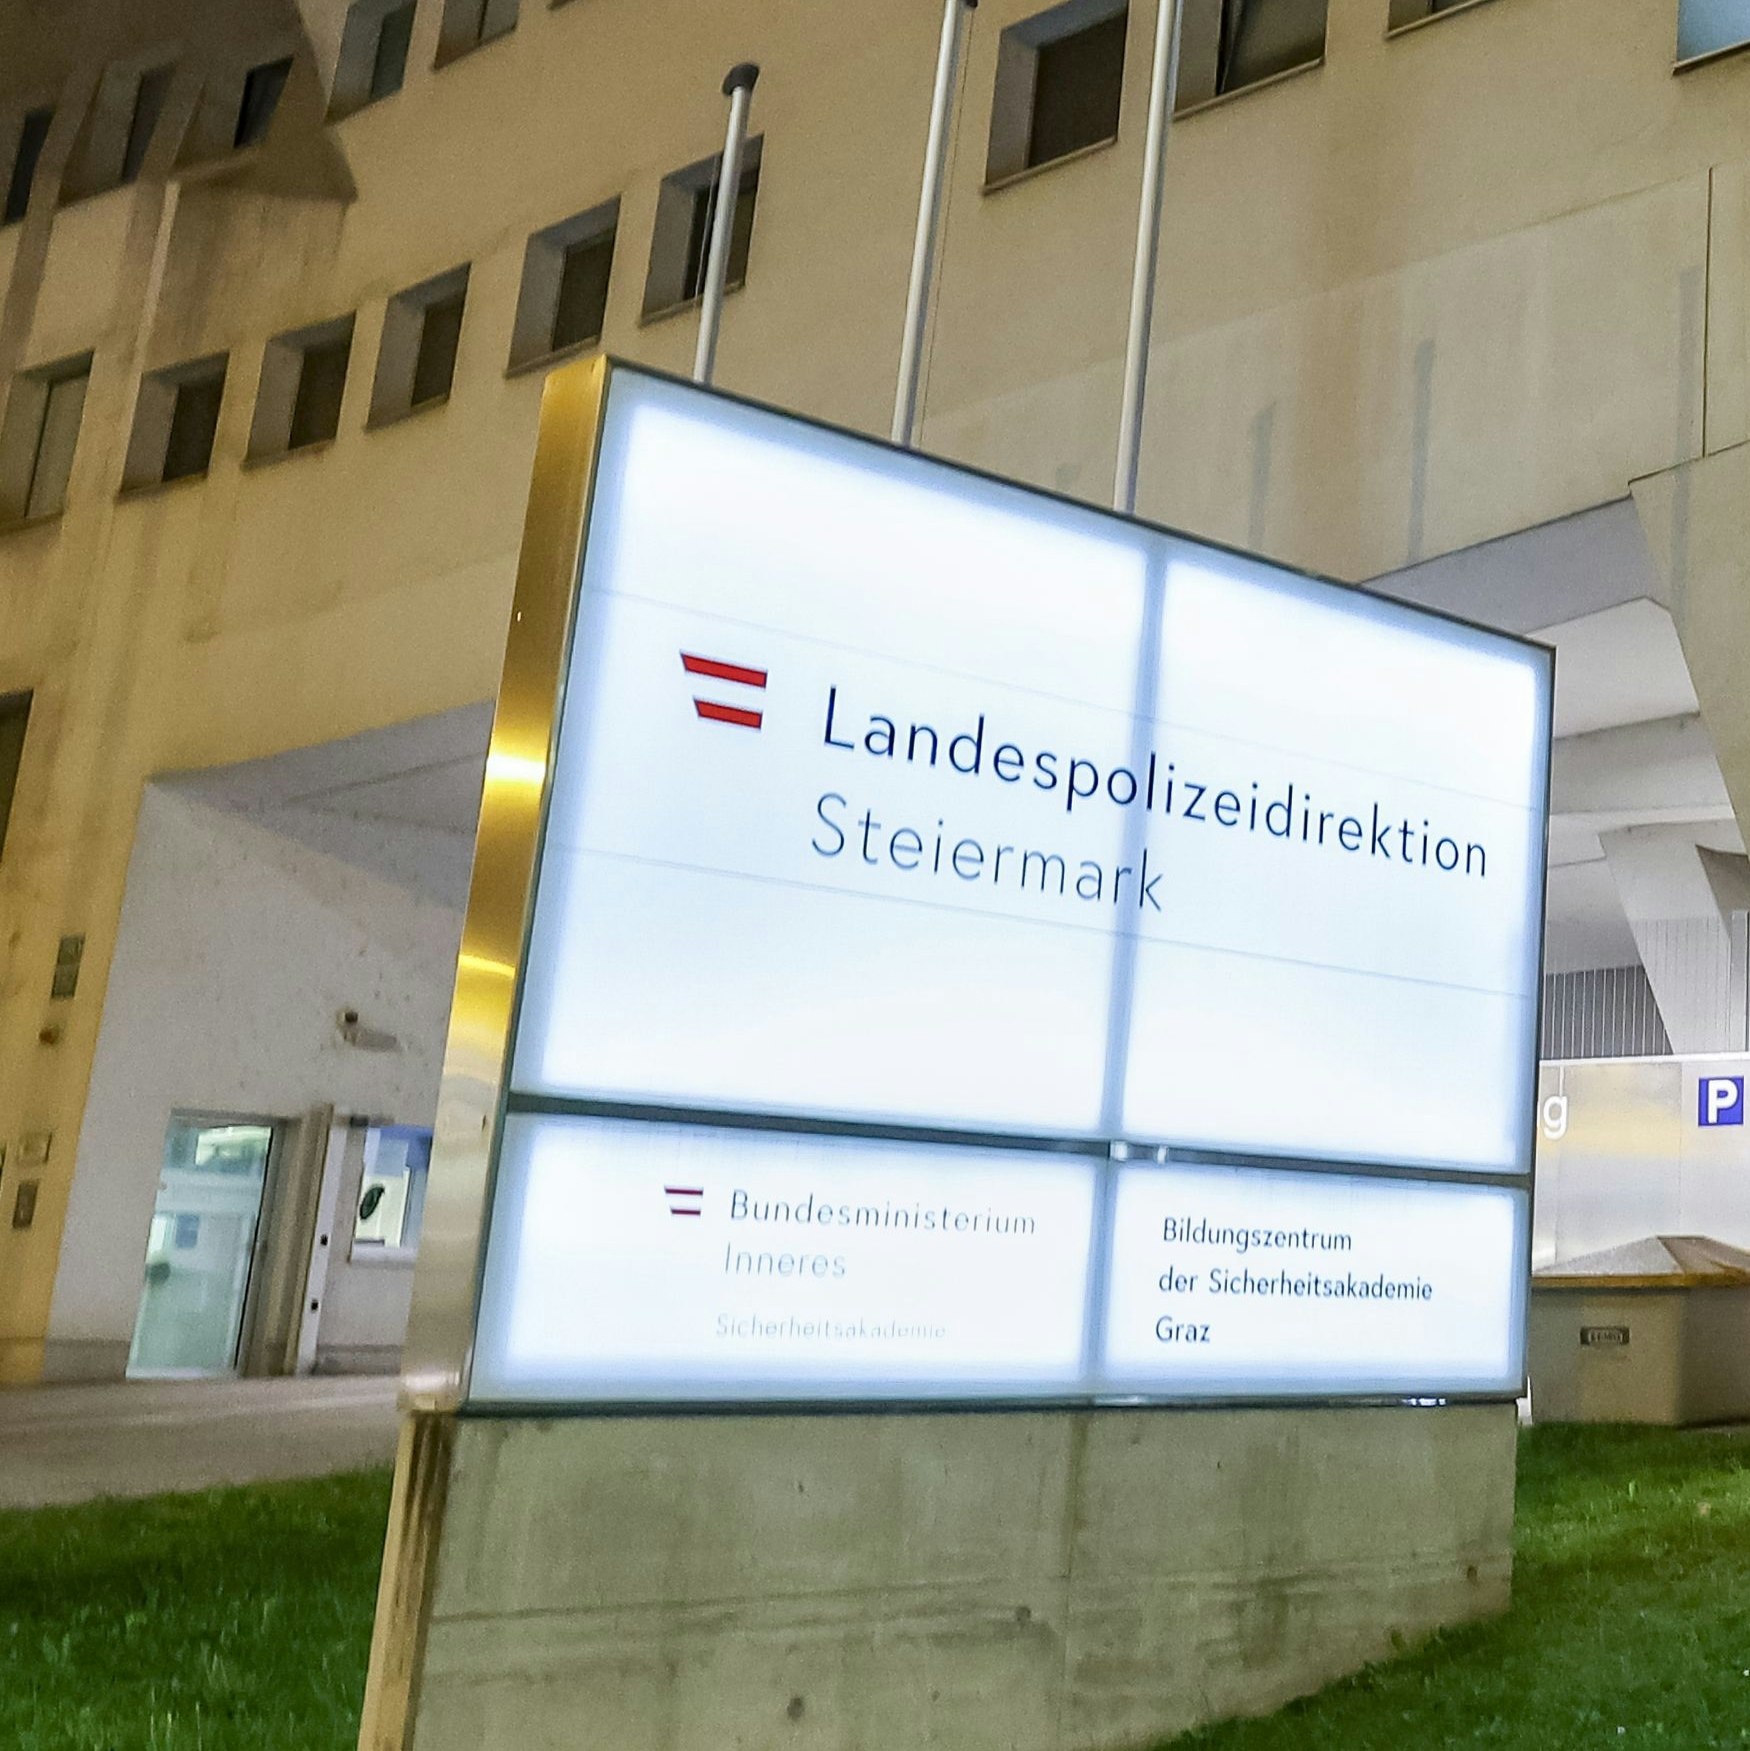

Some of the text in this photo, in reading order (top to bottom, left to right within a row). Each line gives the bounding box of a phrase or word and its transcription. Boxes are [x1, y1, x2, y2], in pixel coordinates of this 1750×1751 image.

[822, 684, 1489, 879] Landespolizeidirektion
[810, 791, 1164, 913] Steiermark
[730, 1187, 1036, 1235] Bundesministerium
[1162, 1216, 1352, 1254] Bildungszentrum
[725, 1241, 846, 1279] Inneres
[1158, 1265, 1433, 1301] der Sicherheitsakademie
[1155, 1314, 1211, 1343] Graz
